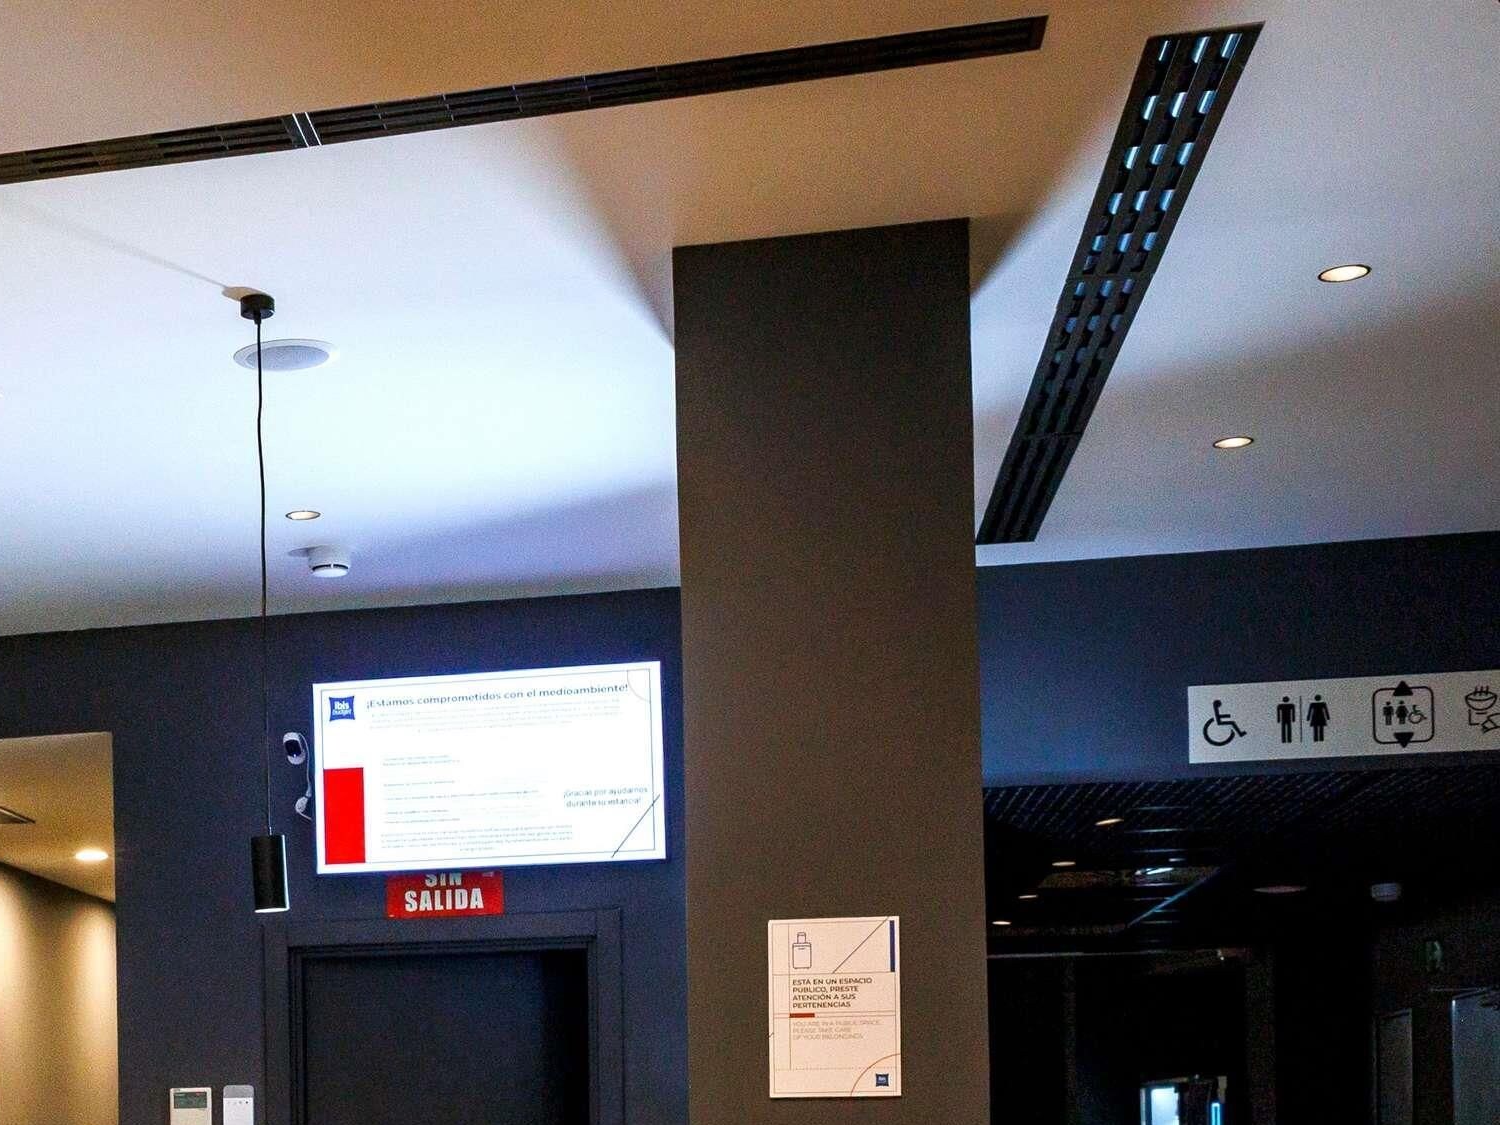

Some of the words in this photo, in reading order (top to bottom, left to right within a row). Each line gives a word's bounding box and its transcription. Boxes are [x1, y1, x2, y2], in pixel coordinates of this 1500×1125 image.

[417, 692, 502, 705] comprometidos
[504, 691, 524, 700] con
[526, 688, 536, 698] el
[539, 683, 628, 697] medioambiente!
[404, 887, 485, 912] SALIDA
[825, 977, 837, 985] UN
[839, 977, 873, 985] ESPACIO
